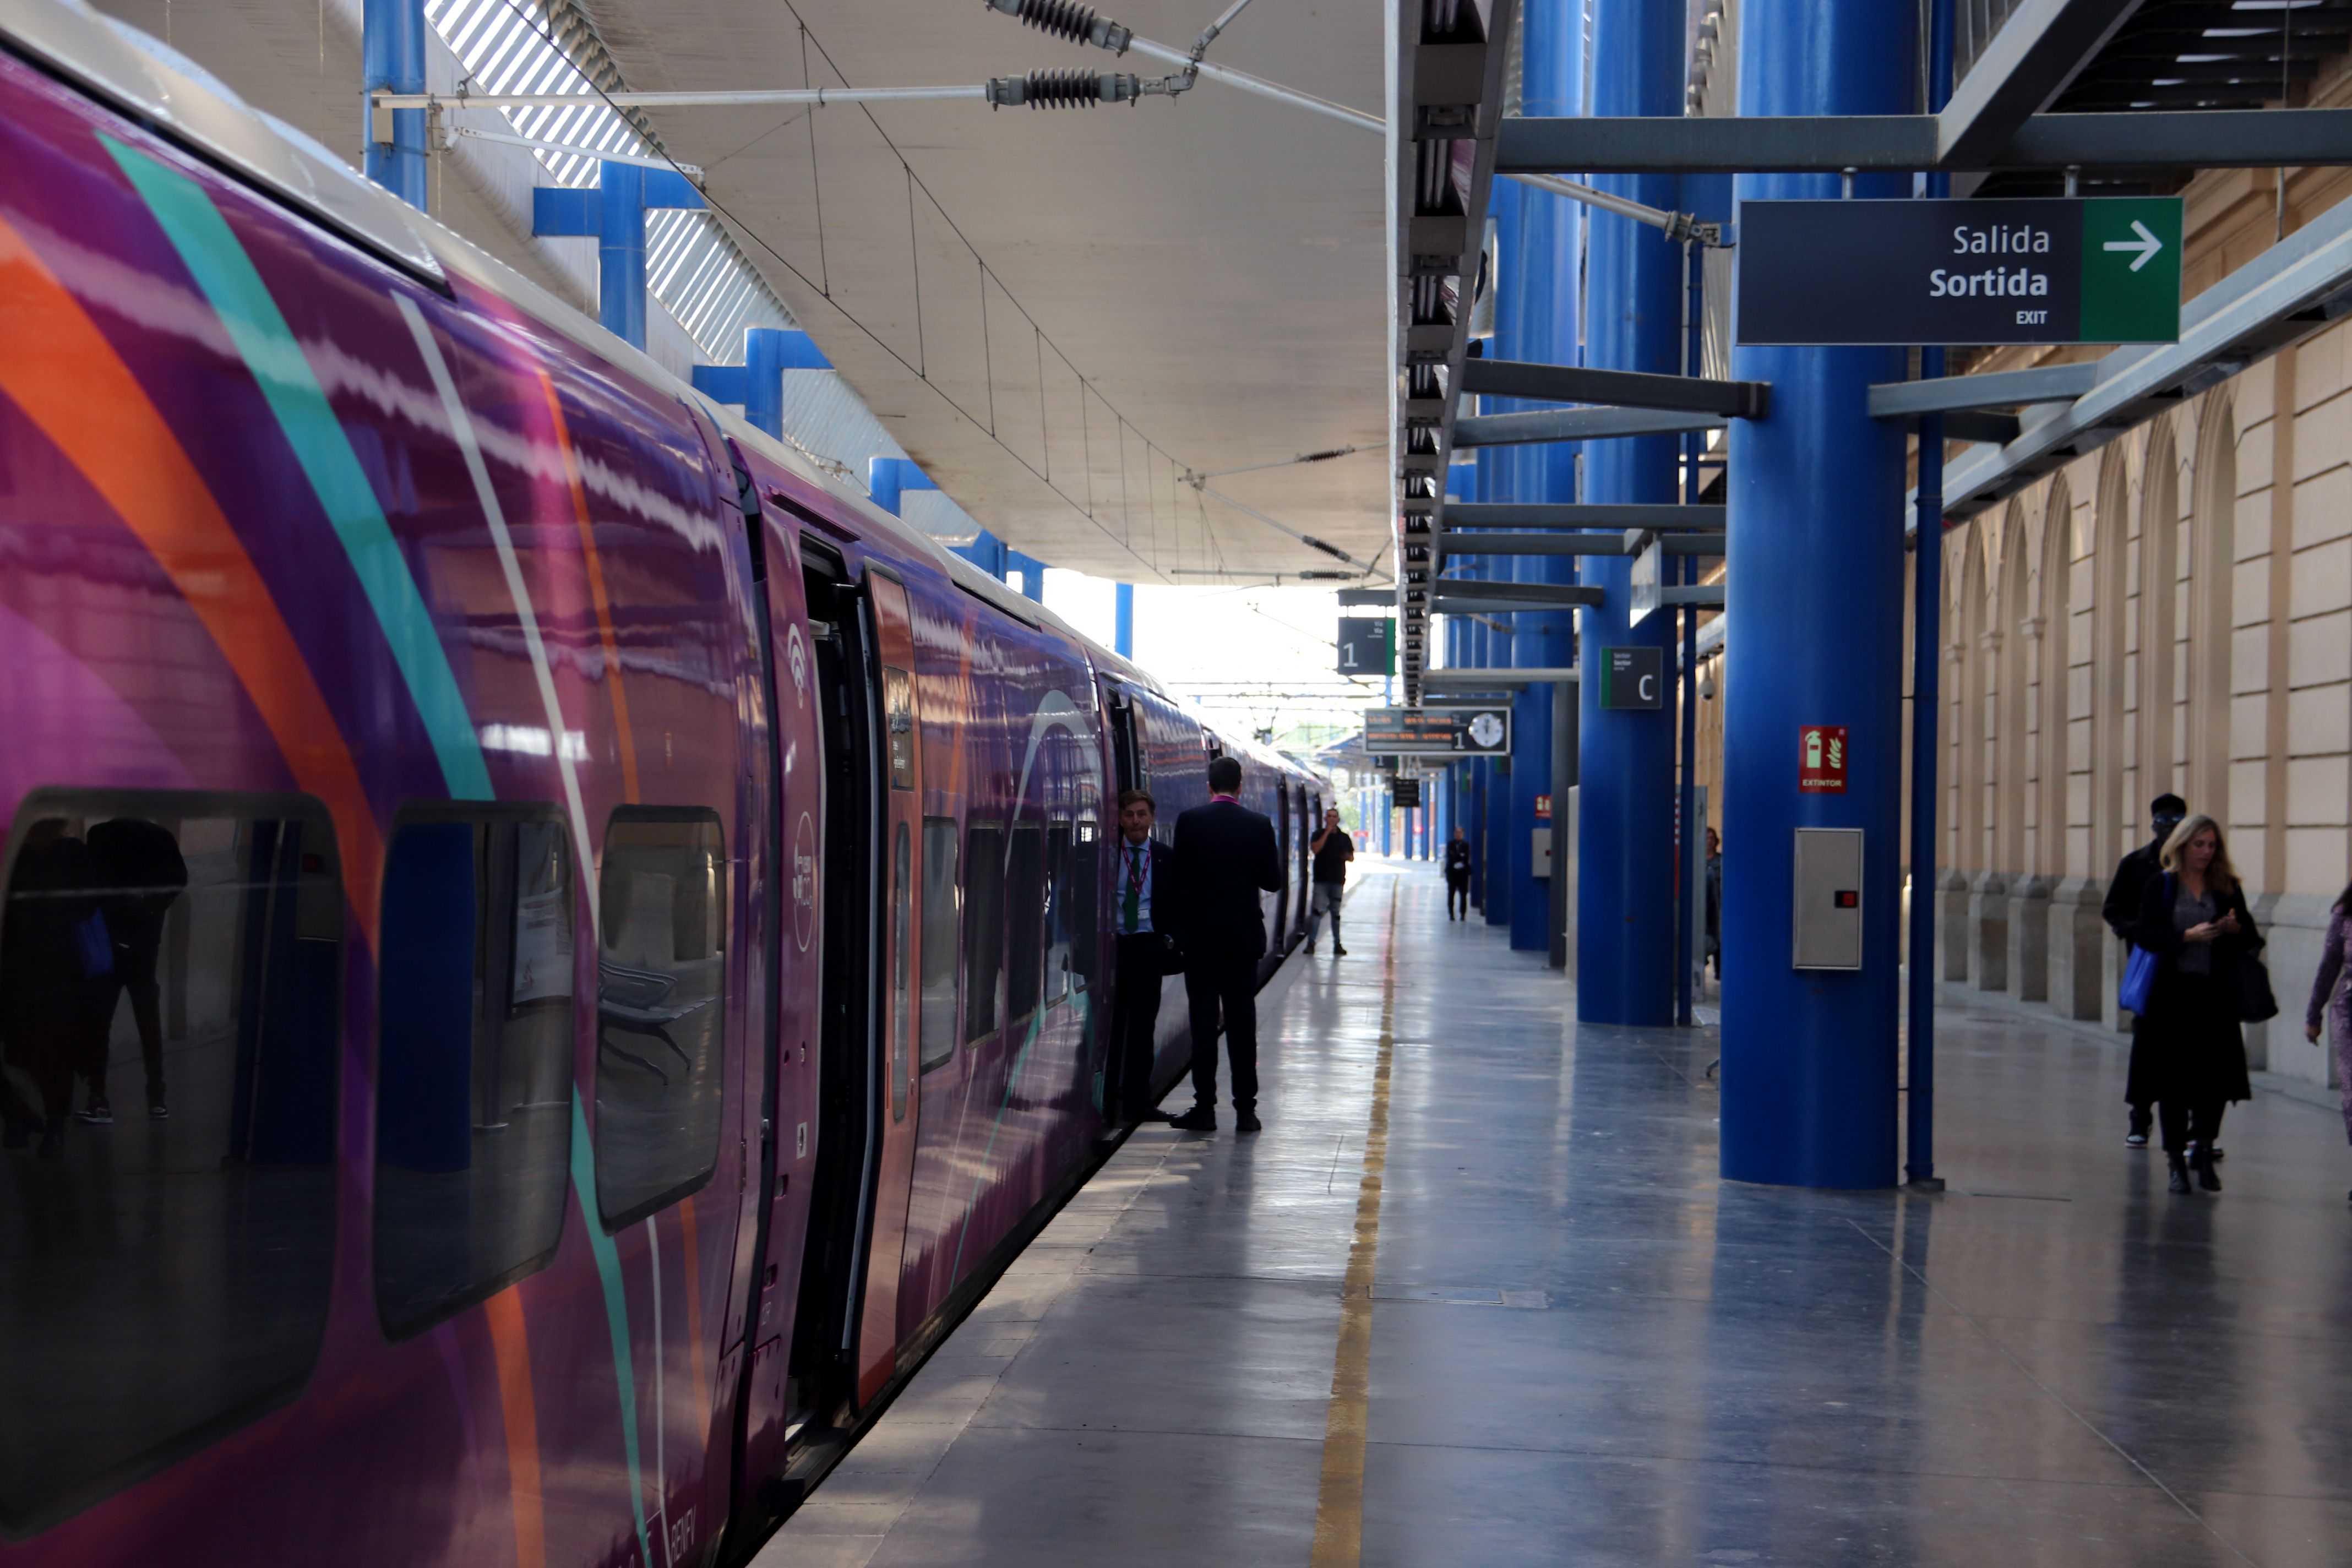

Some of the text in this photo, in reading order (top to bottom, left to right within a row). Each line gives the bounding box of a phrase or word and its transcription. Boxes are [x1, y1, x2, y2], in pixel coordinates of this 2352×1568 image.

[1953, 225, 2050, 254] Salida
[1929, 266, 2048, 297] Sortida
[2016, 311, 2048, 324] EXIT
[1343, 642, 1358, 667] 1
[1638, 674, 1653, 701] C
[1454, 731, 1464, 749] 1
